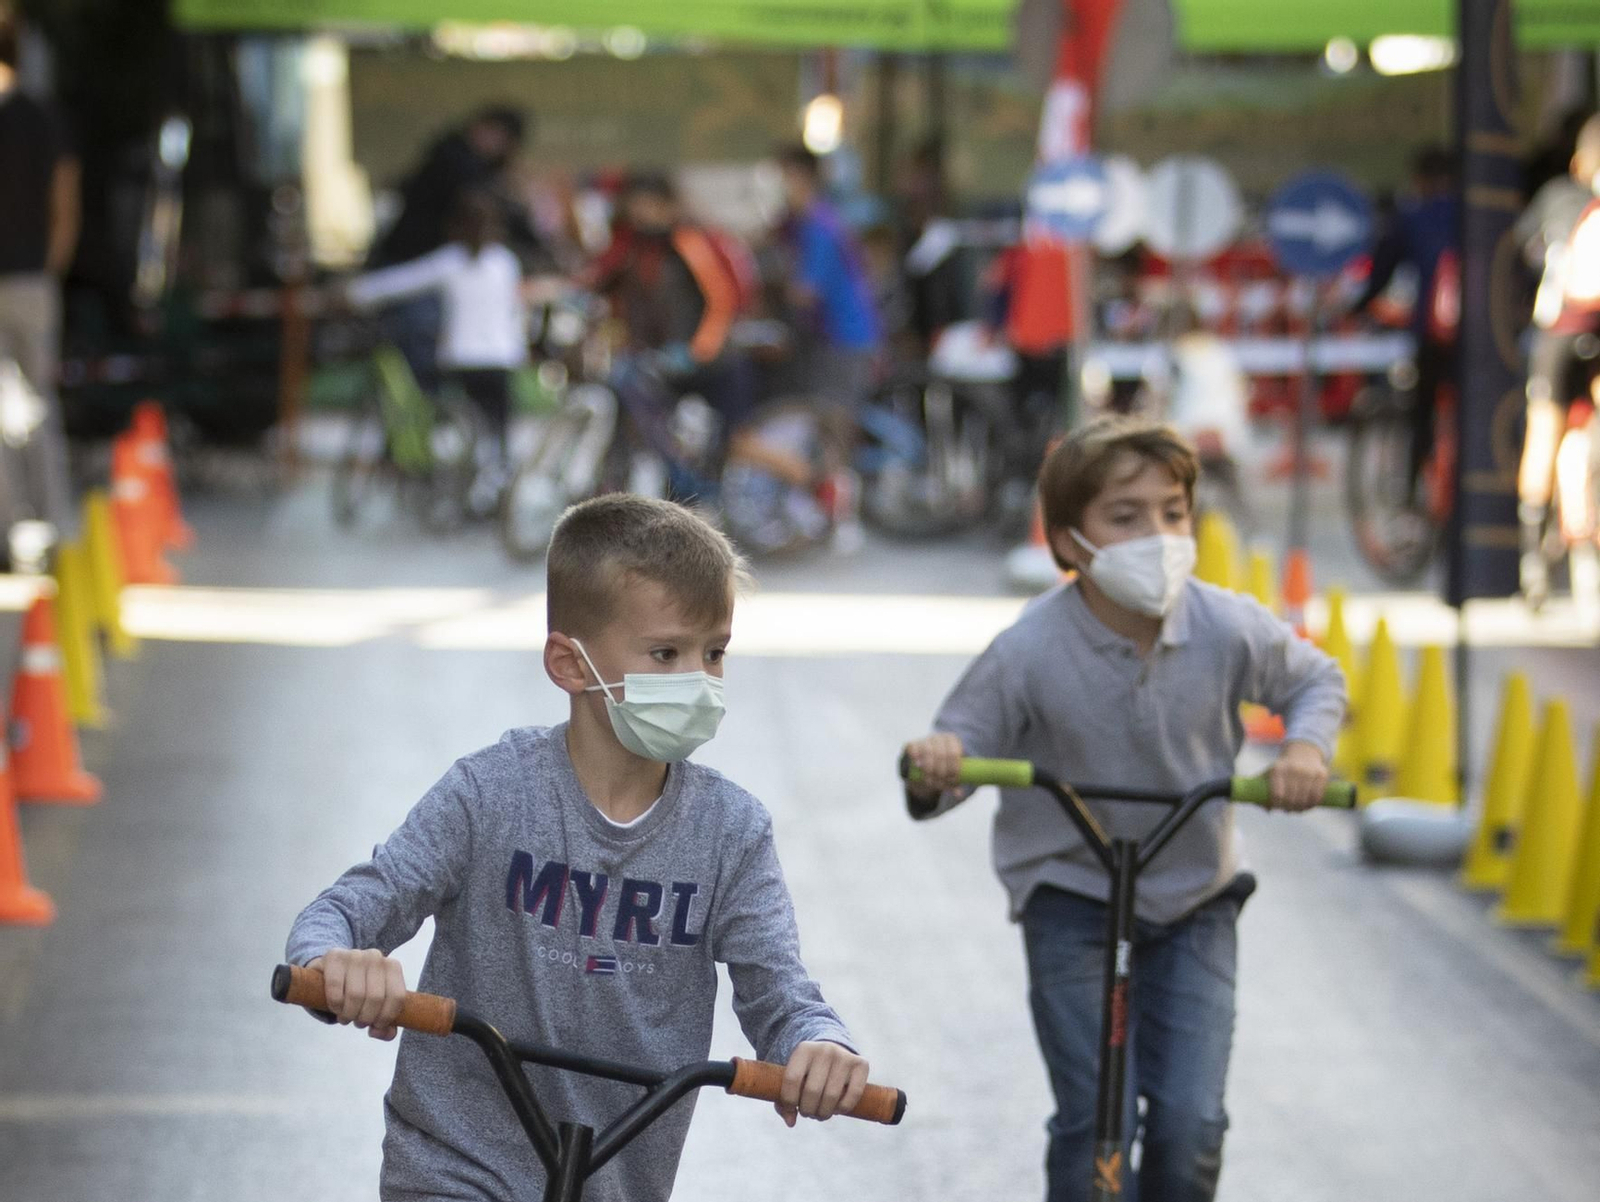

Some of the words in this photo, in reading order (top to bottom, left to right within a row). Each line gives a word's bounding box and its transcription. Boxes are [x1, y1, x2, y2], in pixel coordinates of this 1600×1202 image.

[506, 850, 704, 947] MYRL
[538, 946, 578, 969] COOL
[617, 959, 655, 974] OYS
